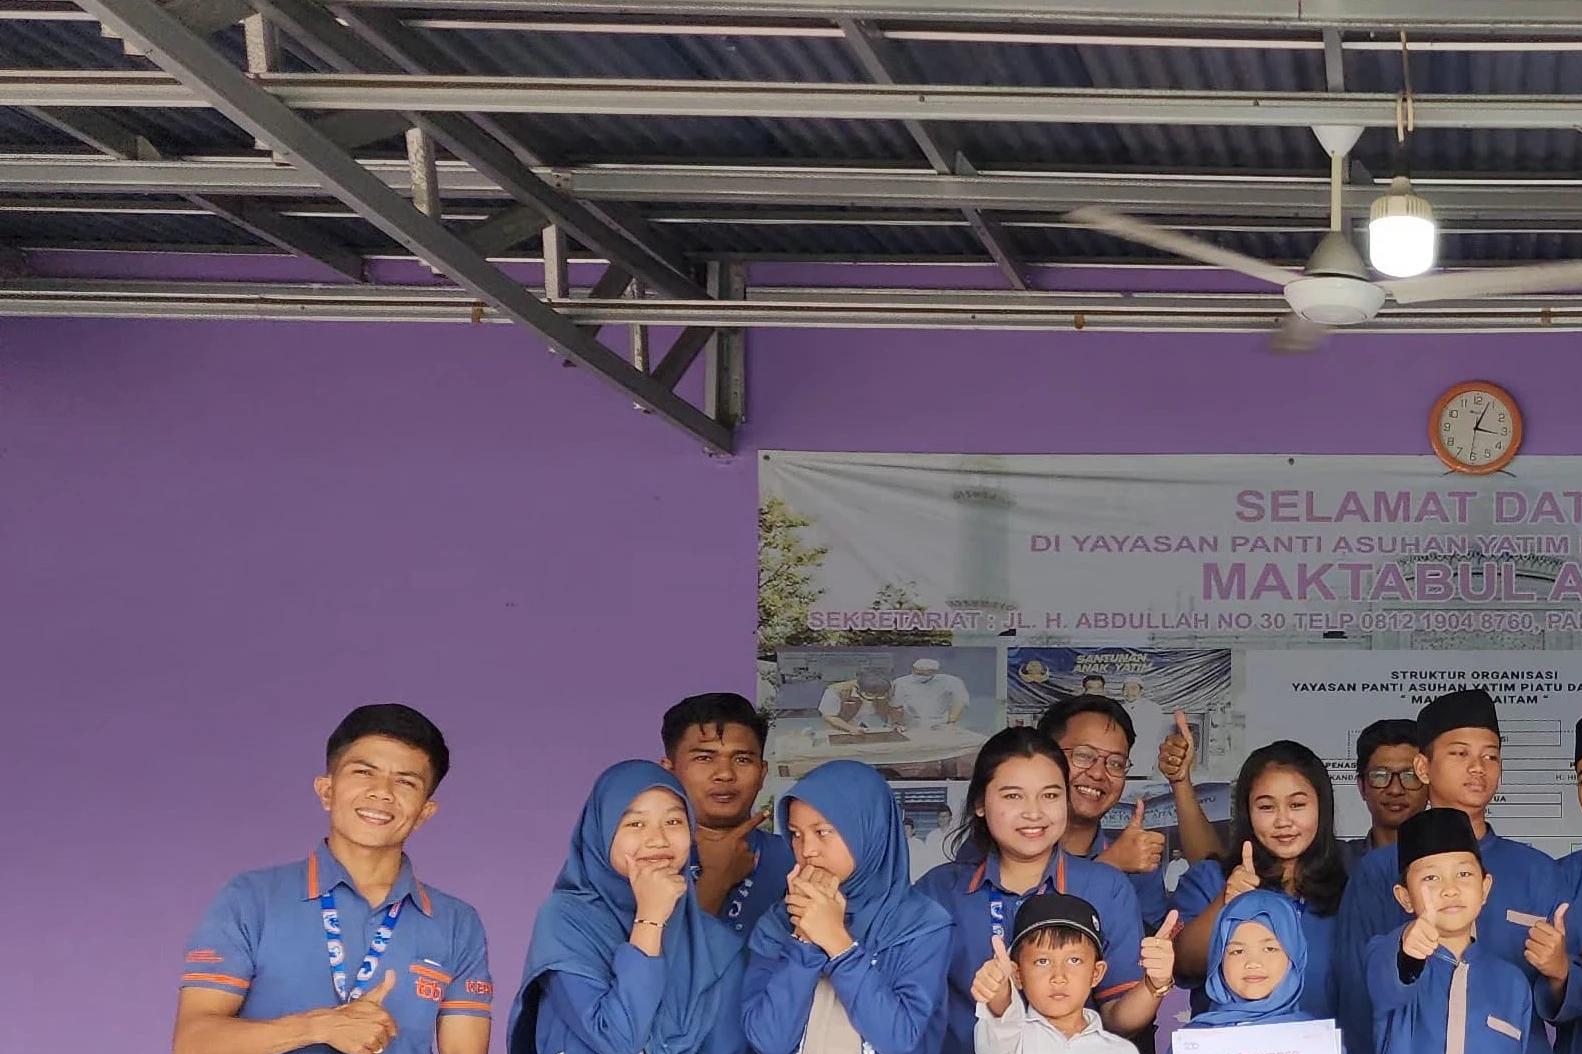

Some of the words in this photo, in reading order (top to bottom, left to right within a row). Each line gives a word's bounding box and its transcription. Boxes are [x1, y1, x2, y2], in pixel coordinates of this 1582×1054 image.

[1235, 489, 1478, 523] SELAMAT
[1030, 534, 1060, 553] DI
[1072, 534, 1219, 553] YAYASAN
[1231, 535, 1322, 553] PANTI
[1332, 535, 1467, 554] ASUHAN
[1478, 535, 1569, 554] YATIM
[1202, 562, 1536, 601] MAKTABUL
[809, 611, 981, 629] SEKRETARIAT
[1003, 612, 1037, 630] JL.
[1046, 612, 1067, 629] H.
[1075, 612, 1209, 630] ABDULLAH
[1217, 612, 1252, 630] NO
[1260, 612, 1286, 630] 30
[1295, 612, 1353, 630] TELP
[1361, 612, 1413, 631] 0812
[1423, 612, 1473, 631] 1904
[1481, 612, 1539, 634] 8760,
[1391, 670, 1466, 680] STRUKTUR
[1471, 670, 1558, 680] ORGANISASI
[1292, 682, 1357, 692] YAYASAN
[1361, 682, 1403, 692] PANTI
[1408, 682, 1467, 692] ASUHAN
[1520, 682, 1563, 692] PIATU
[1492, 695, 1538, 705] AITAM
